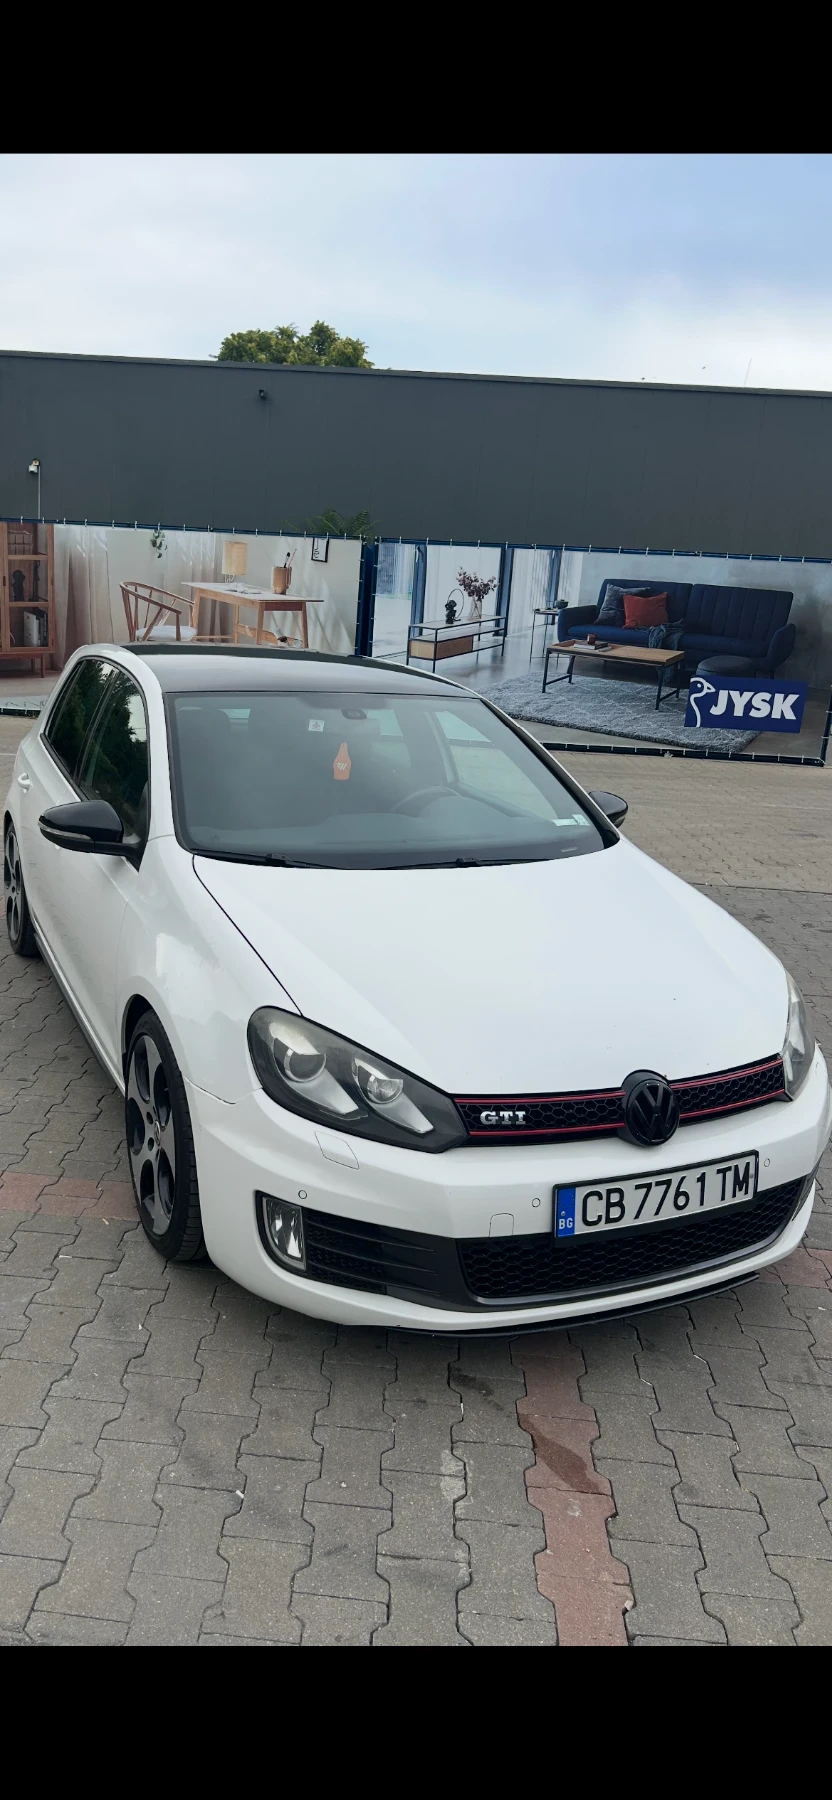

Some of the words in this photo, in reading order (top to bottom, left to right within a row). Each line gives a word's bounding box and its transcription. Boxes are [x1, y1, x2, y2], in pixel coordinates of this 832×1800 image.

[709, 690, 799, 720] JYSK
[480, 1110, 526, 1125] GTI
[581, 1187, 626, 1227] CB
[633, 1171, 706, 1220] 7761
[716, 1161, 751, 1202] TM
[558, 1217, 573, 1230] BG
